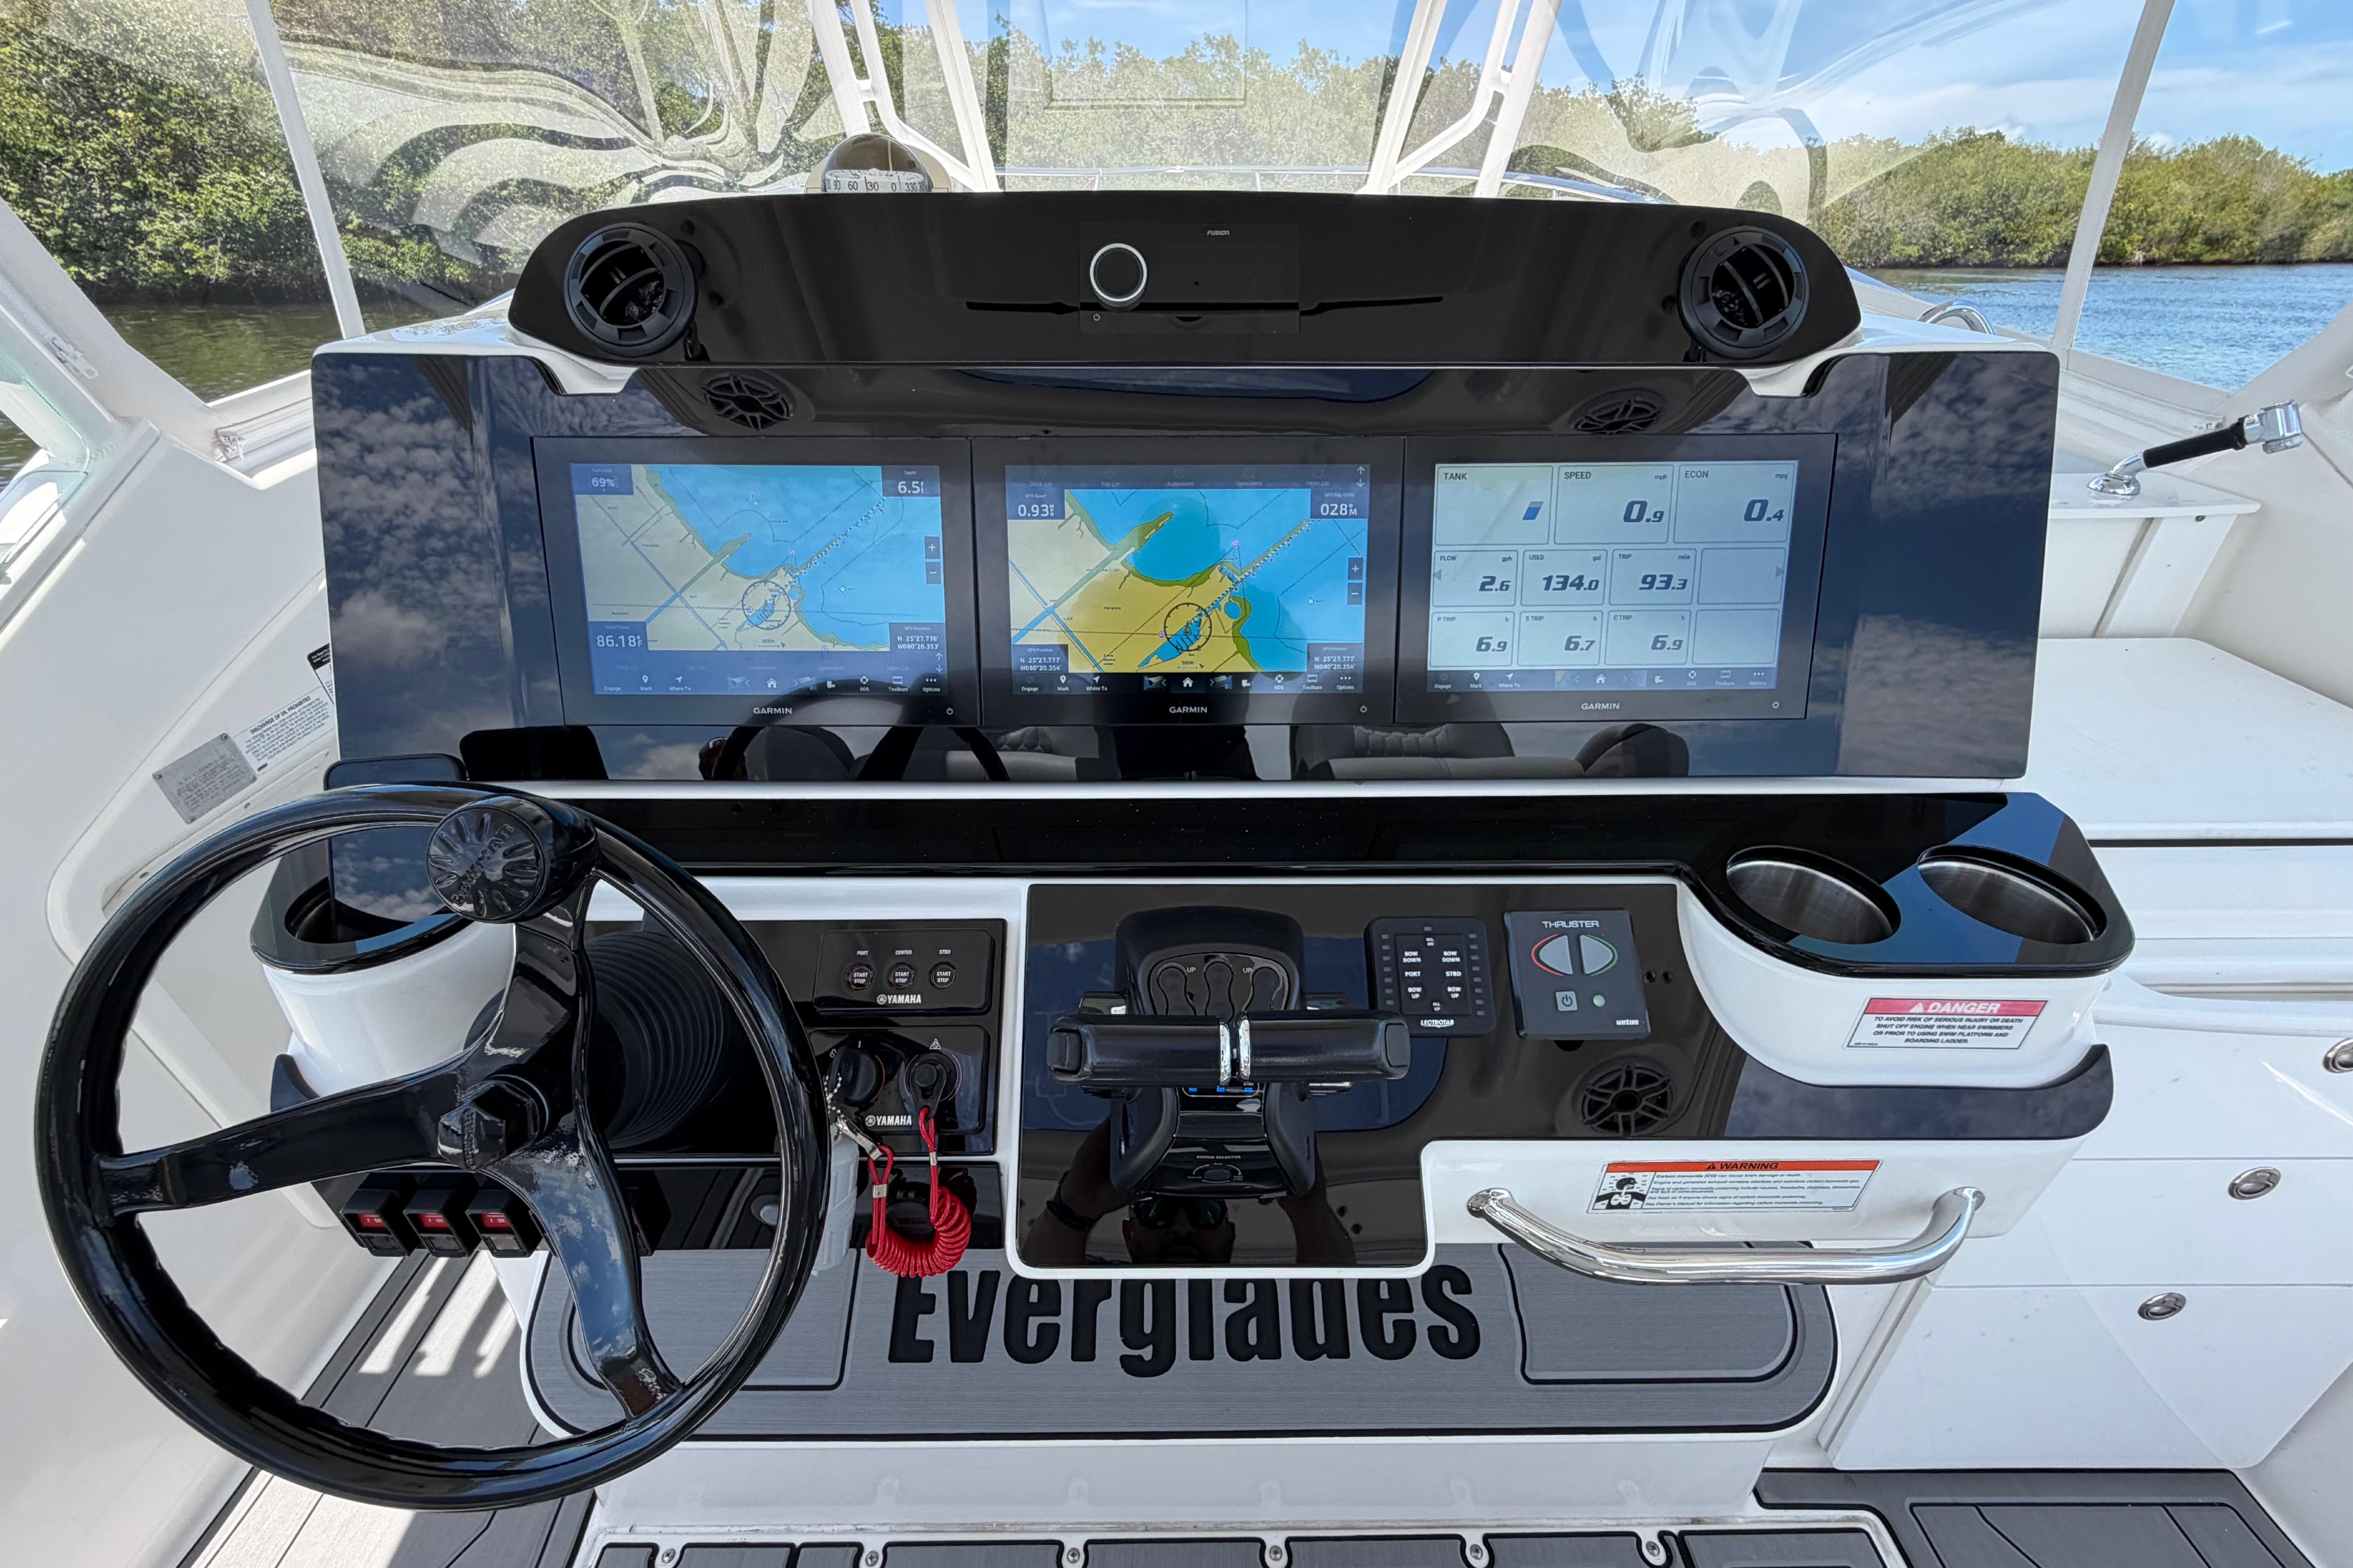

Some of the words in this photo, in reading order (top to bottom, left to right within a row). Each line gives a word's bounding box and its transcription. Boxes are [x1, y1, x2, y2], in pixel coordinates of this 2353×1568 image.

[848, 181, 858, 191] 60
[867, 182, 879, 191] 30
[891, 183, 897, 192] 0
[905, 183, 918, 192] 330
[592, 478, 615, 487] 69%
[1623, 500, 1664, 522] 0.9
[1744, 499, 1784, 521] 0.4
[1478, 576, 1511, 591] 2.6
[1542, 575, 1600, 591] 134.0
[1639, 574, 1688, 590] 93.3
[1476, 637, 1508, 652] 6.9
[1564, 636, 1595, 651] 6.7
[1651, 635, 1683, 650] 6.9
[250, 717, 275, 734] DISCHARGE
[887, 994, 921, 1004] YAMAHA
[1927, 1002, 2001, 1013] DANGER
[876, 1115, 912, 1126] YAMAHA
[888, 1264, 1481, 1377] Everglades
